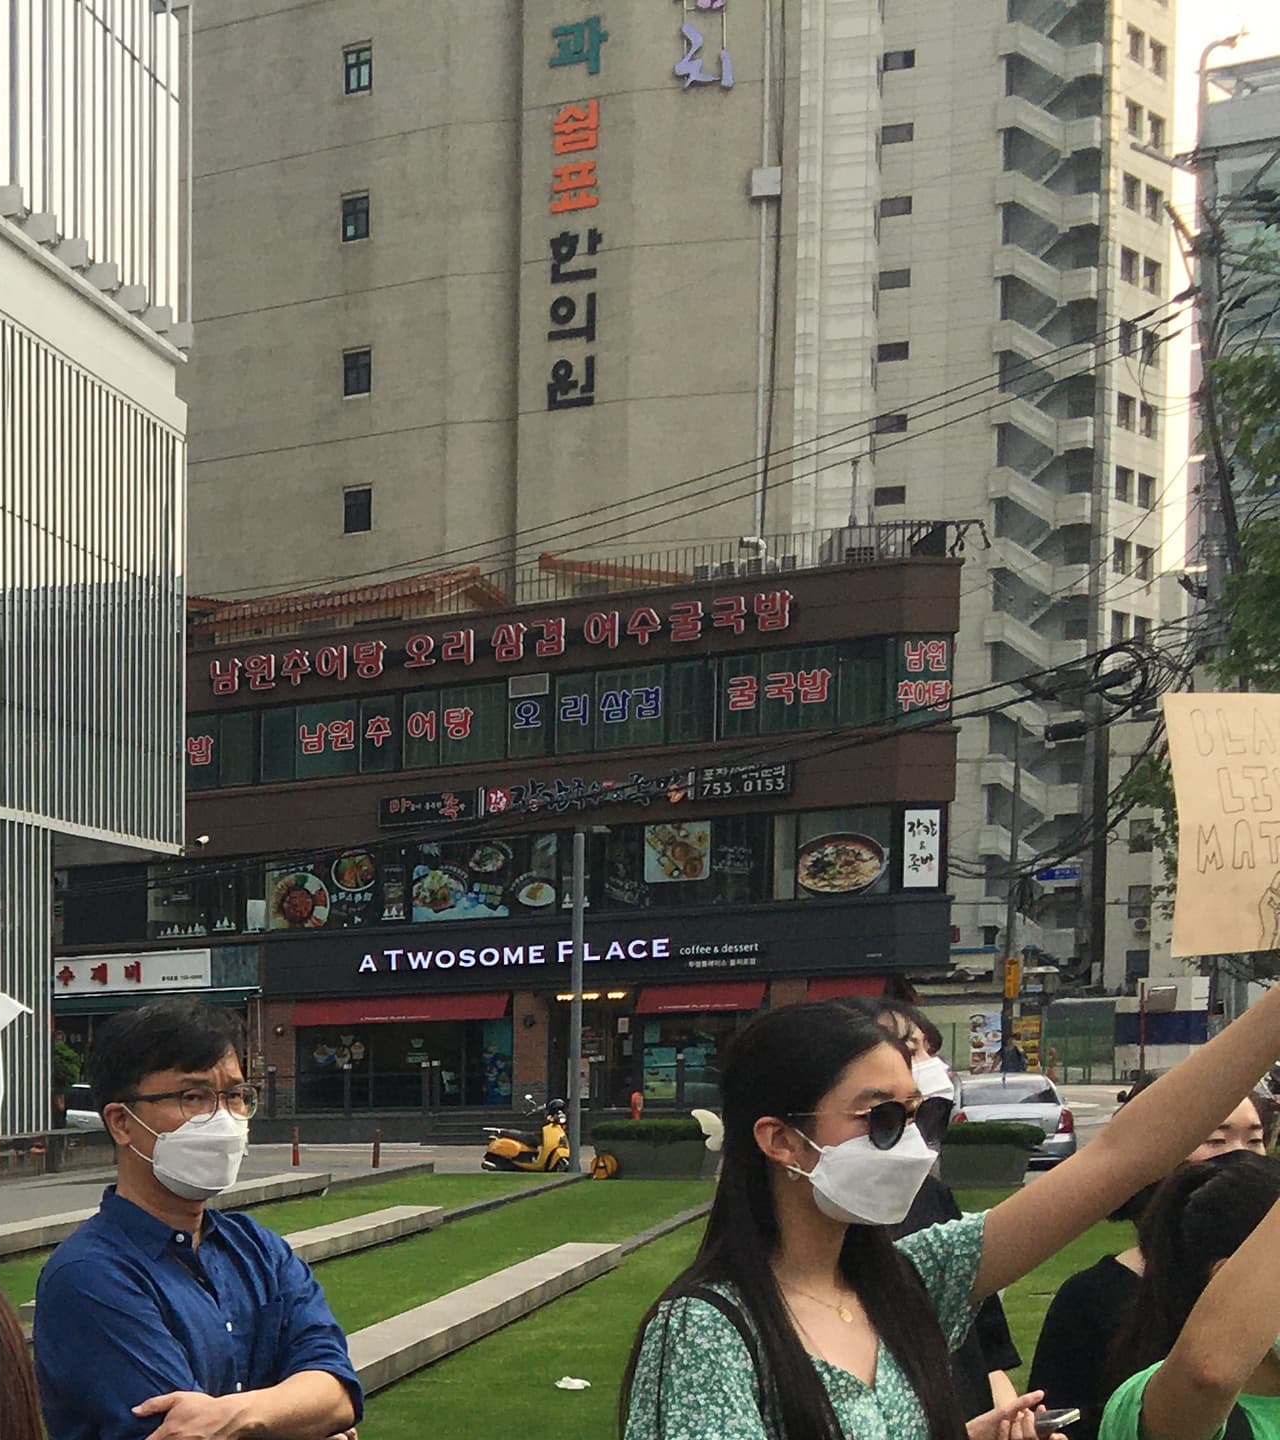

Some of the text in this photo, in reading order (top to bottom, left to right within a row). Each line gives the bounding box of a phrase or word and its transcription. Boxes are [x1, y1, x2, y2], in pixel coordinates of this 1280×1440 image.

[548, 15, 609, 75] 과
[674, 0, 734, 89] 리
[547, 99, 603, 411] 쉼표 한의원
[209, 640, 388, 696] 남원추어탕
[583, 589, 793, 648] 여수굴국밥
[904, 640, 947, 672] 남원
[727, 667, 832, 712] 굴국밥
[897, 680, 953, 712] 추어탕
[187, 735, 214, 766] 밥
[1217, 766, 1280, 814] LI
[358, 954, 377, 973] A
[384, 944, 546, 972] TWOSOME
[680, 945, 712, 955] coffee
[721, 944, 759, 953] dessert
